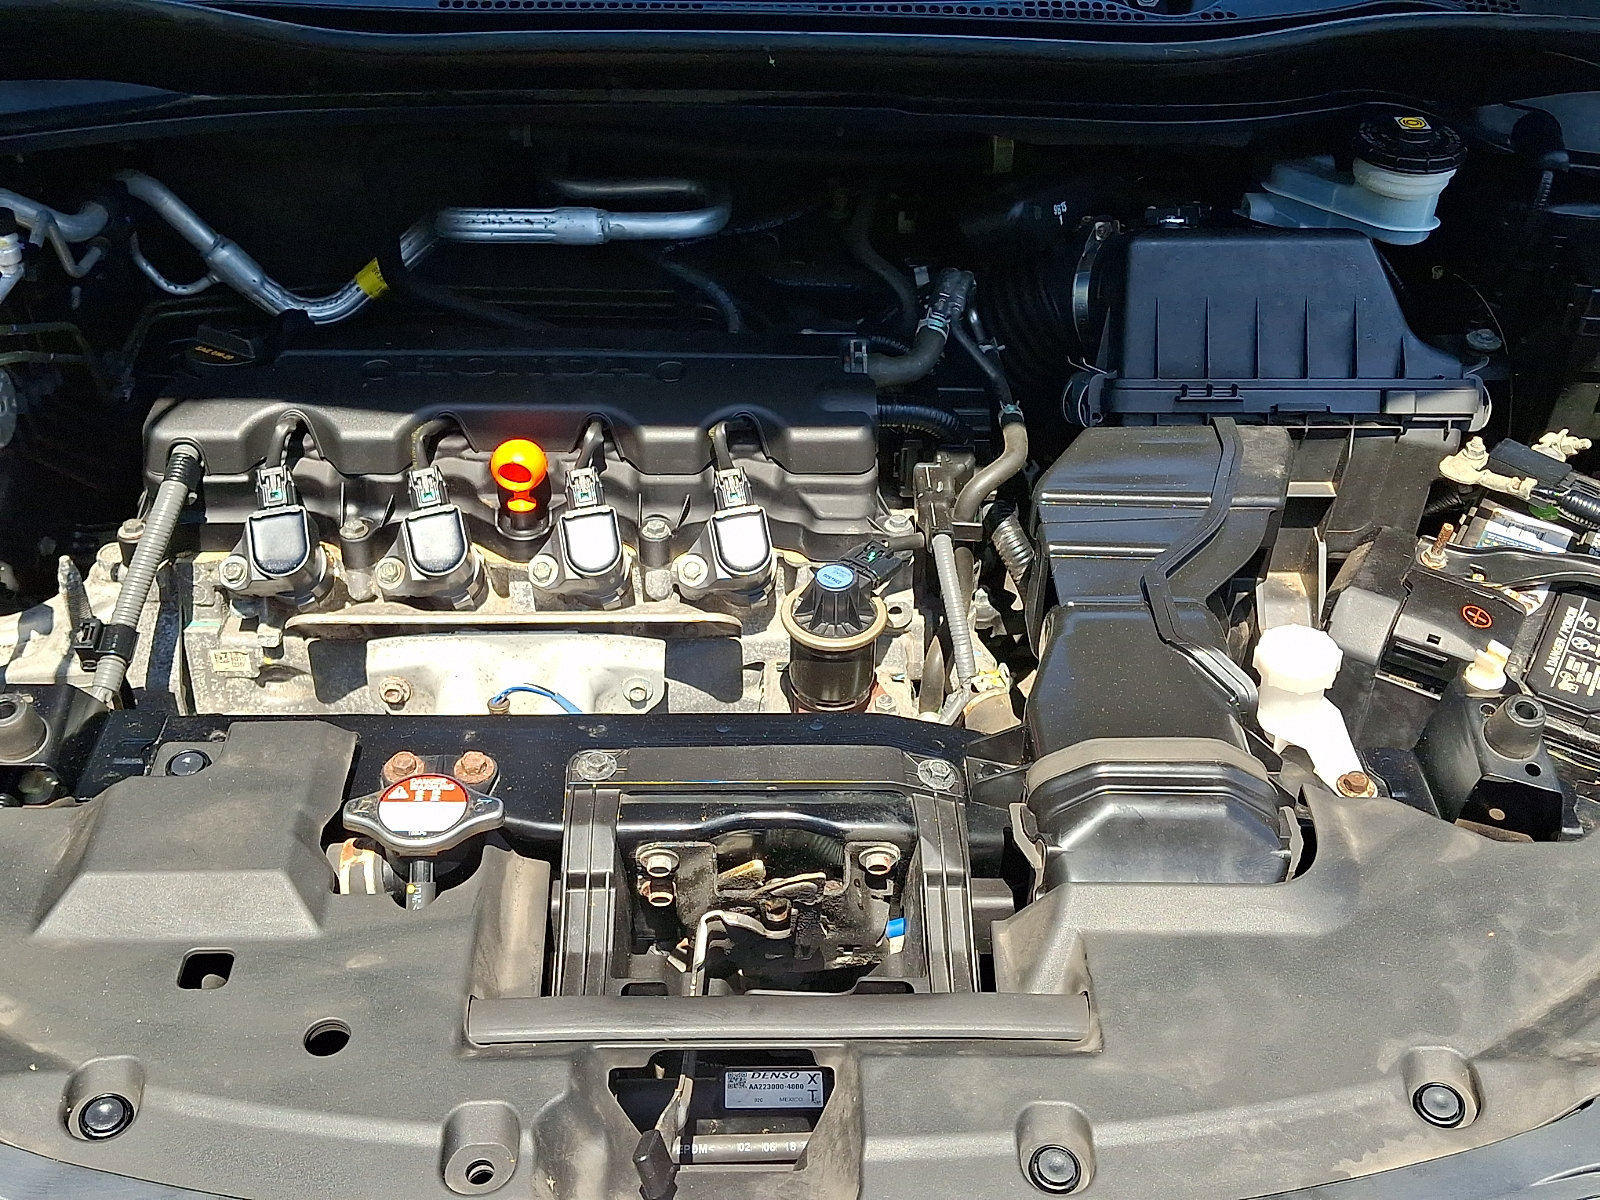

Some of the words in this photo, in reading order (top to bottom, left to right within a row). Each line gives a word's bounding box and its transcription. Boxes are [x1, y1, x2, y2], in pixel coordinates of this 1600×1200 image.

[1546, 636, 1567, 668] DANGER
[1559, 606, 1579, 634] POISON
[807, 1073, 818, 1084] X
[807, 1089, 818, 1102] T
